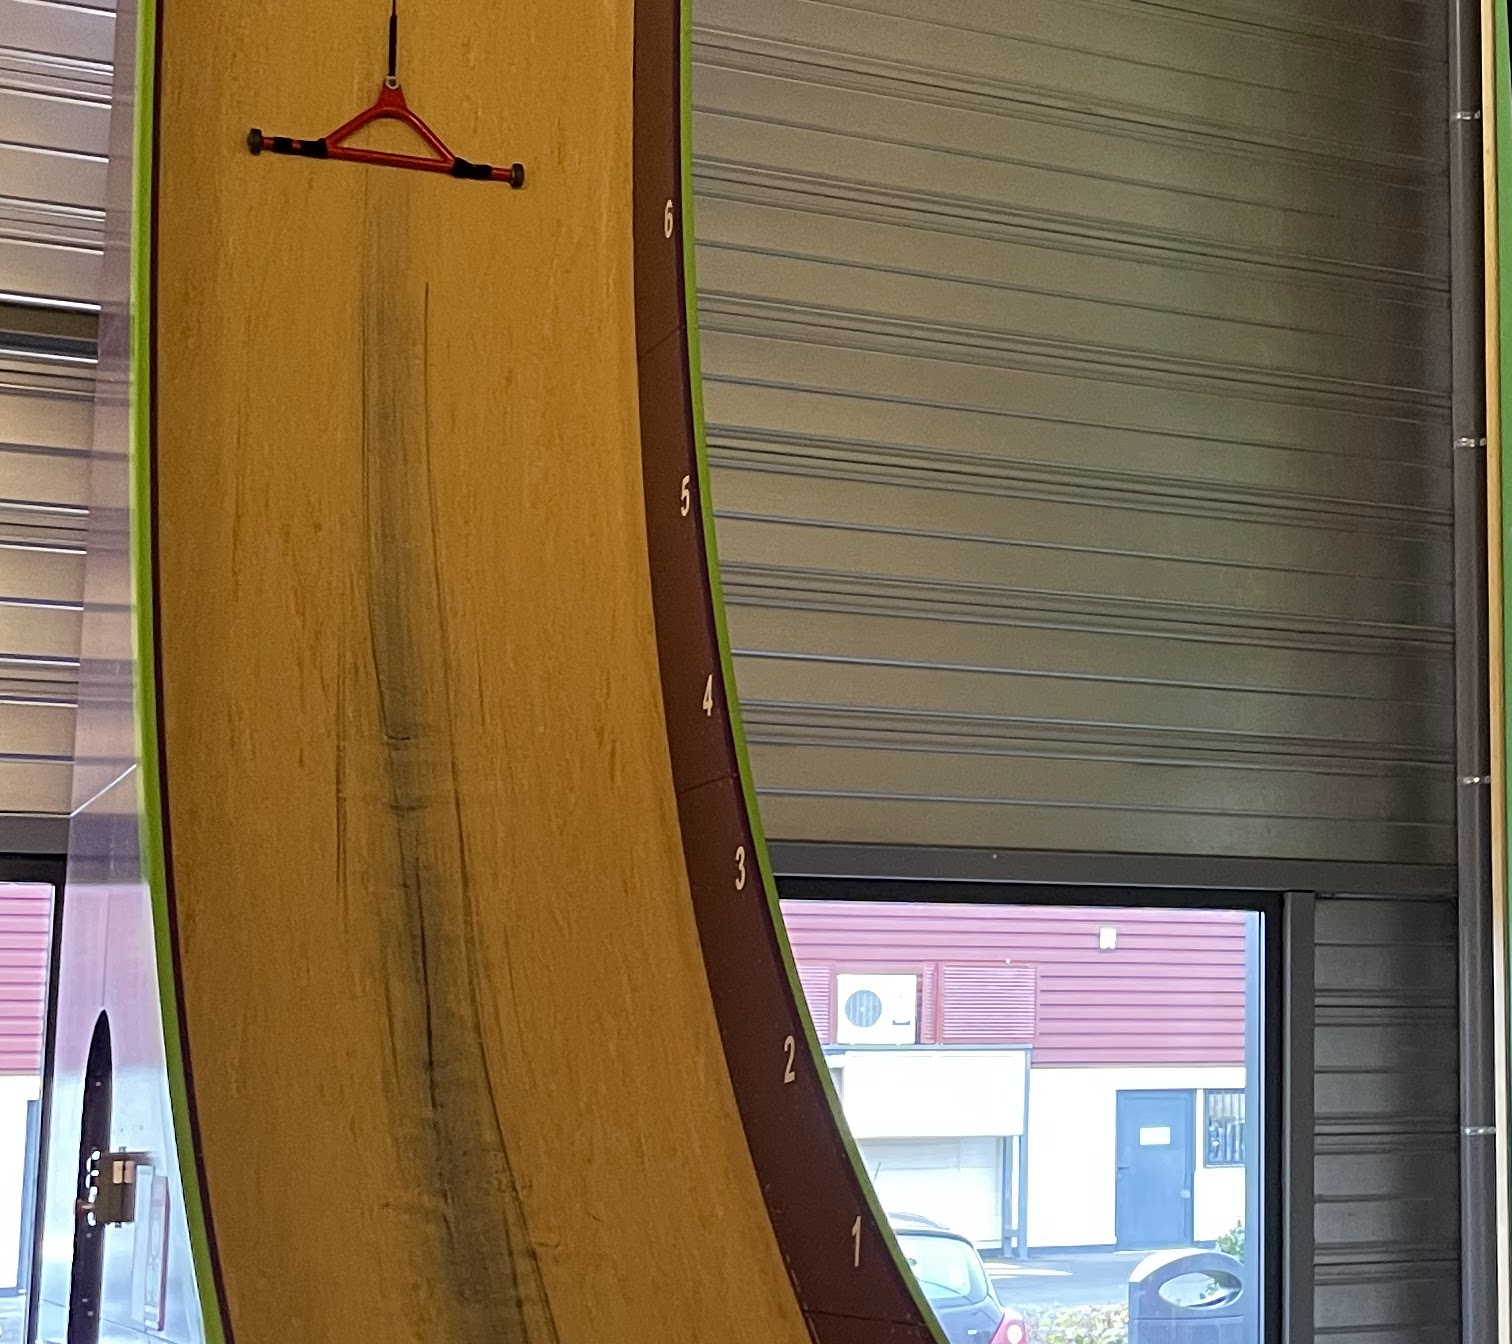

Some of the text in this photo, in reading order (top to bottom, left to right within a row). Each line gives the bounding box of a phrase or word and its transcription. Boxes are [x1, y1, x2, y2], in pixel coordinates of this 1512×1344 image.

[664, 199, 674, 239] 6
[680, 474, 690, 517] 5
[702, 674, 713, 717] 4
[735, 845, 746, 891] 3
[783, 1035, 795, 1084] 2
[851, 1215, 862, 1267] 1
